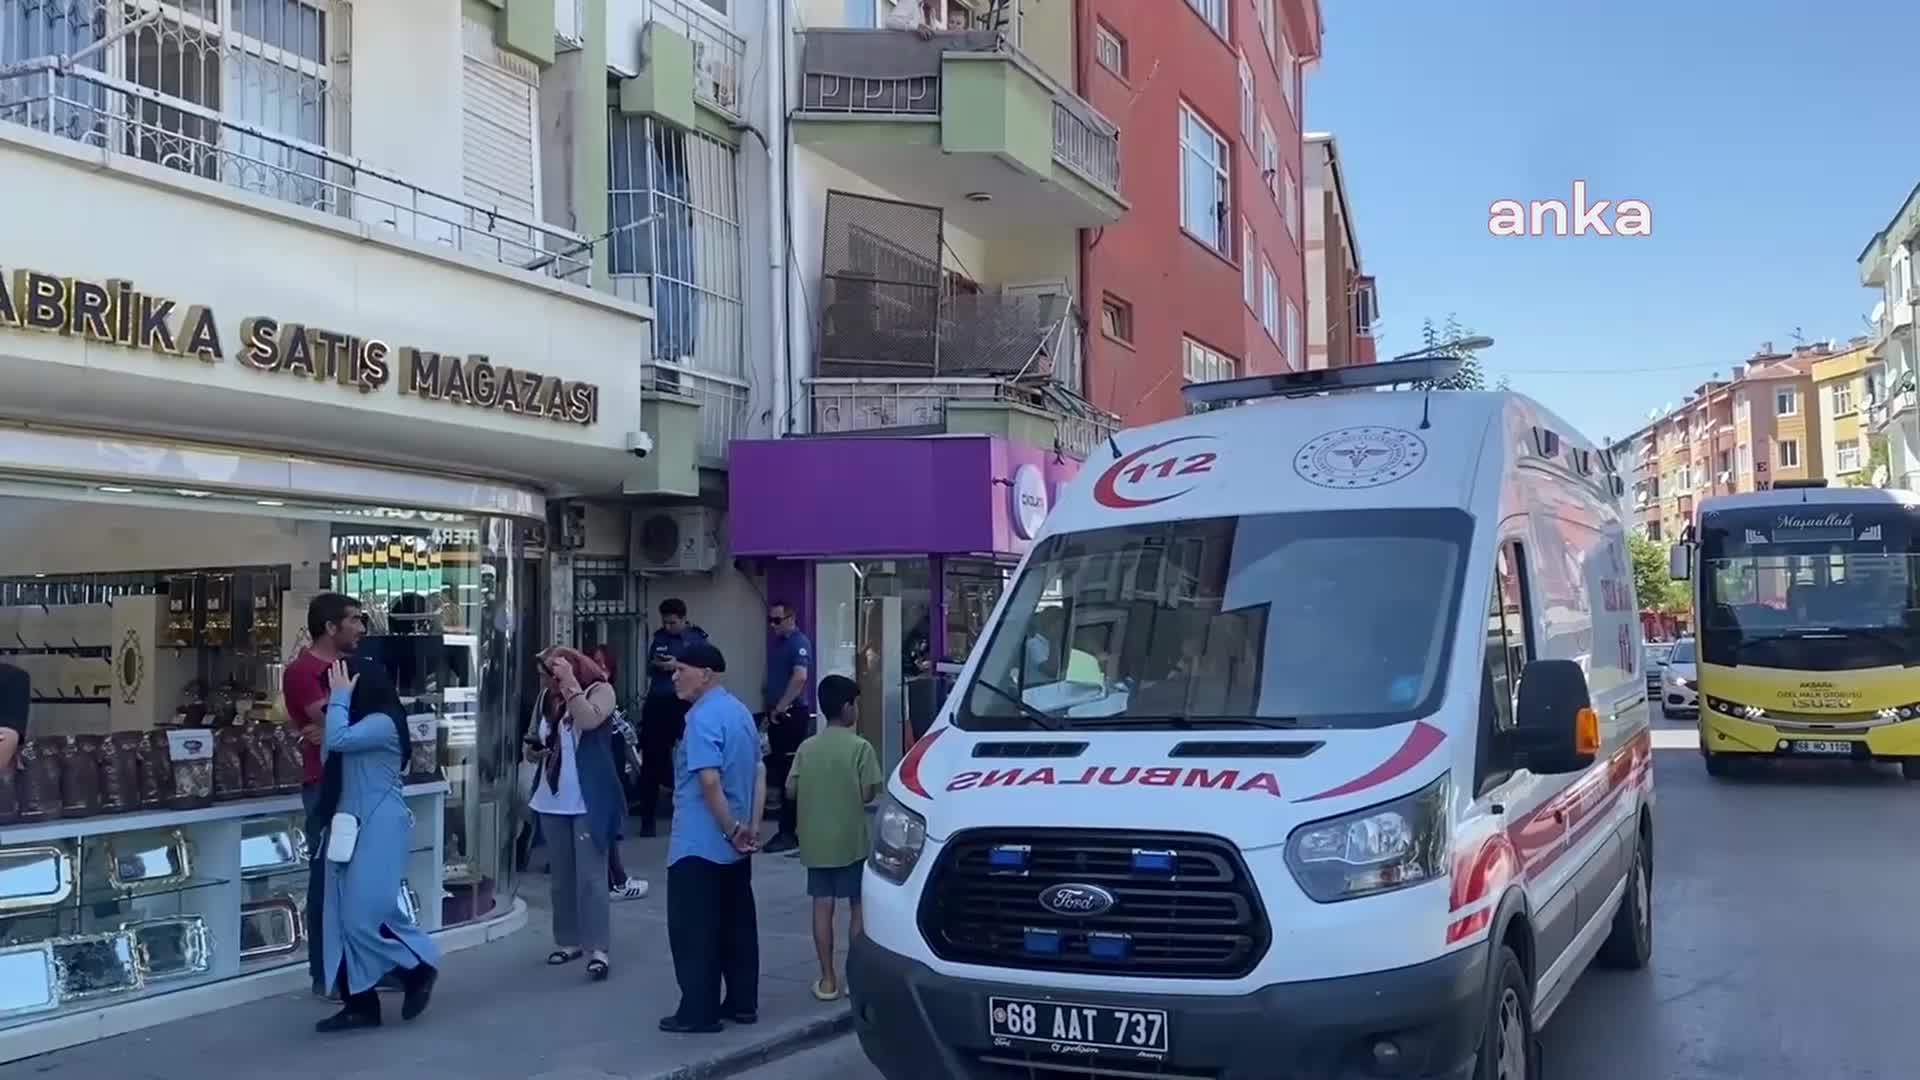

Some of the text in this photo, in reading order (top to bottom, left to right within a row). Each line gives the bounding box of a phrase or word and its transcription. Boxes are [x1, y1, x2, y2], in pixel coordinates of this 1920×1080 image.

[240, 318, 390, 392] SATIŞ
[399, 347, 599, 424] MAĞAZASI
[1122, 453, 1217, 483] 112
[1053, 888, 1094, 911] Ford
[1007, 1003, 1162, 1046] 68 AAT 737
